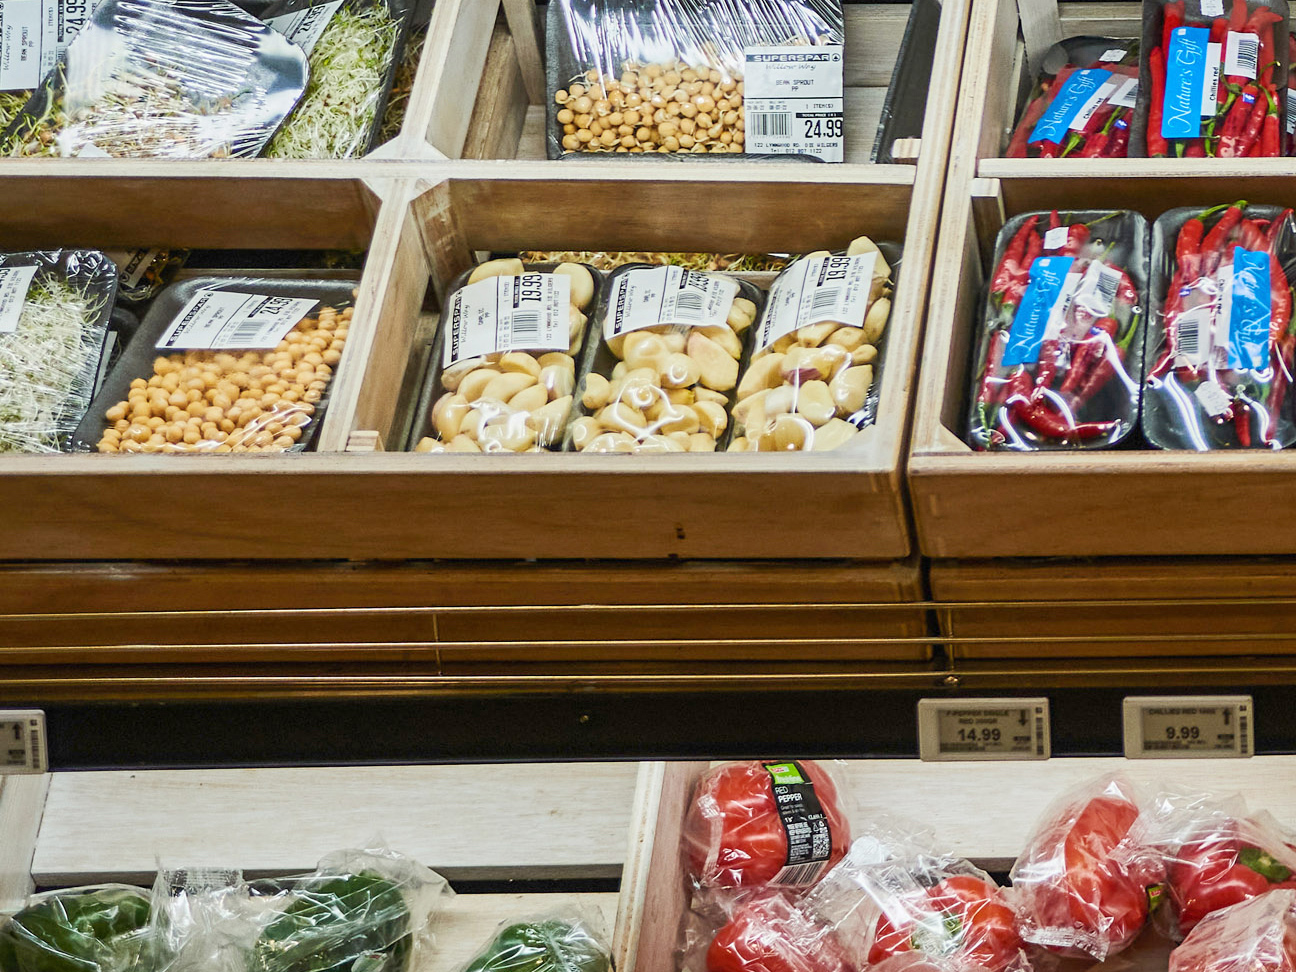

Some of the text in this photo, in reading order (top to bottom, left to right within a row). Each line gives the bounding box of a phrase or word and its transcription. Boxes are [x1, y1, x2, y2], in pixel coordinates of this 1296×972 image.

[297, 6, 325, 34] 24.99
[1168, 37, 1203, 133] Nature's Gift
[1210, 78, 1218, 101] Chillies
[1037, 75, 1094, 136] Nature's Gift
[1096, 97, 1104, 106] red
[805, 119, 843, 138] 24.99
[826, 257, 850, 281] 19.99
[522, 274, 542, 302] 19.99
[260, 298, 293, 315] 24.99
[615, 279, 627, 329] SUPERSPAR
[169, 297, 209, 343] SUPERSPAR
[452, 293, 463, 356] SUPERSPAR
[1010, 297, 1044, 359] Nature's
[958, 728, 1000, 741] 14.99
[1166, 727, 1200, 739] 9.99
[775, 787, 788, 795] RED
[778, 793, 802, 803] PEPPER
